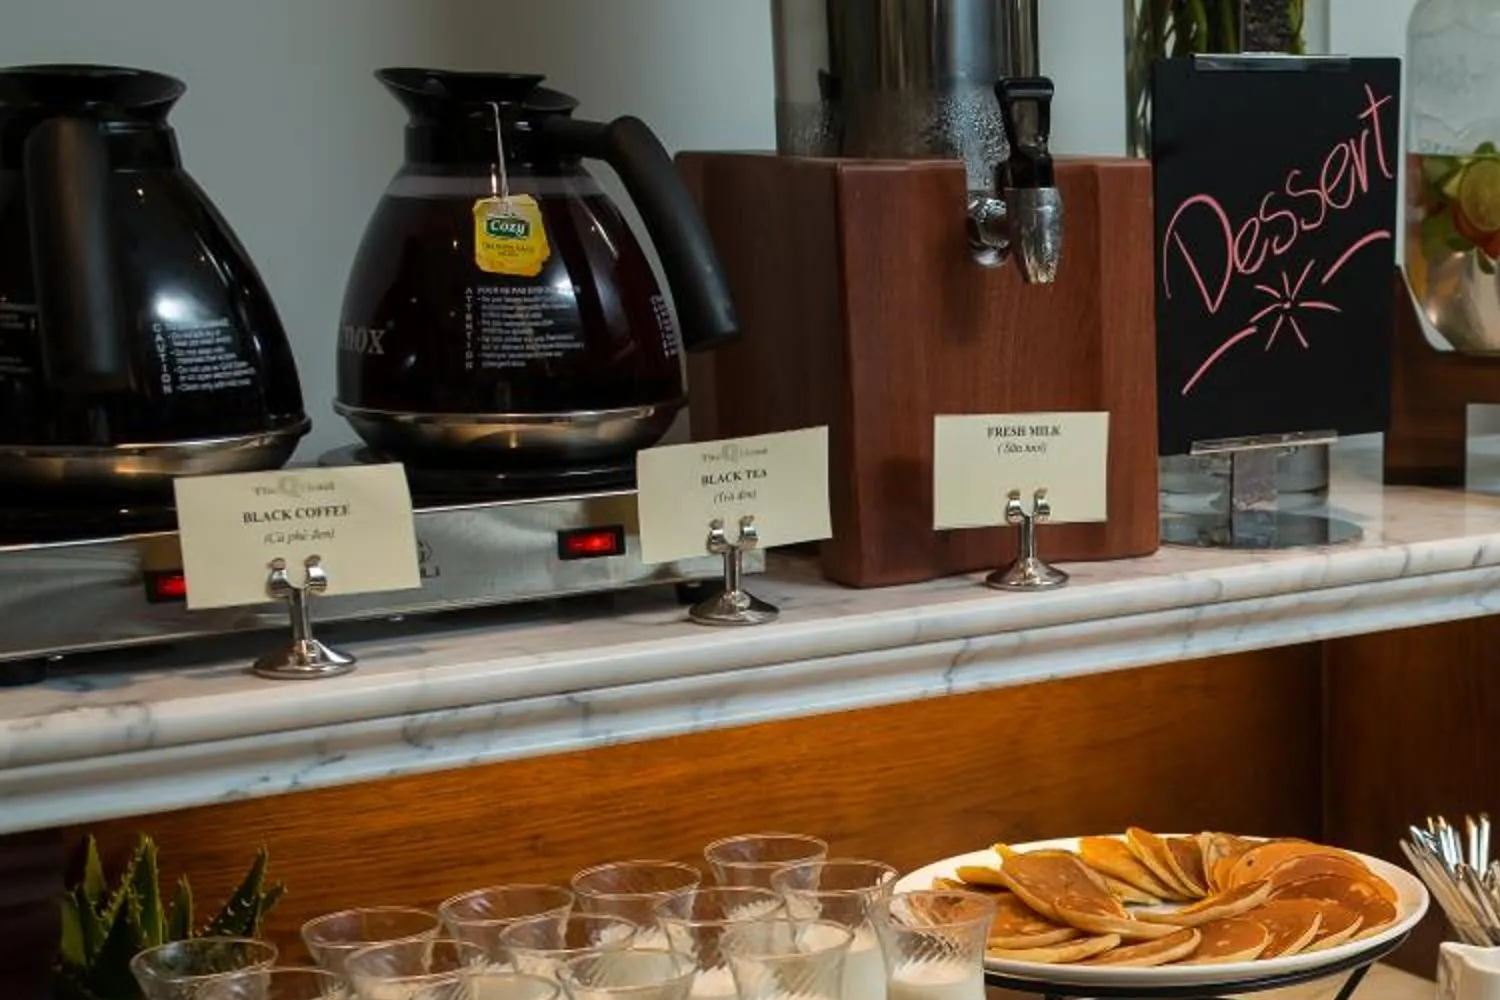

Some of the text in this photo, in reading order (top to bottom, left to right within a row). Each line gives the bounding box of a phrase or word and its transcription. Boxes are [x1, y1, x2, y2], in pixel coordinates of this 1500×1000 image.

[1163, 83, 1393, 315] Dessert
[489, 219, 526, 237] Cozy
[987, 424, 1063, 439] FRESH MILK
[701, 468, 768, 487] BLACK TEA
[241, 503, 352, 525] BLACK COFFEE
